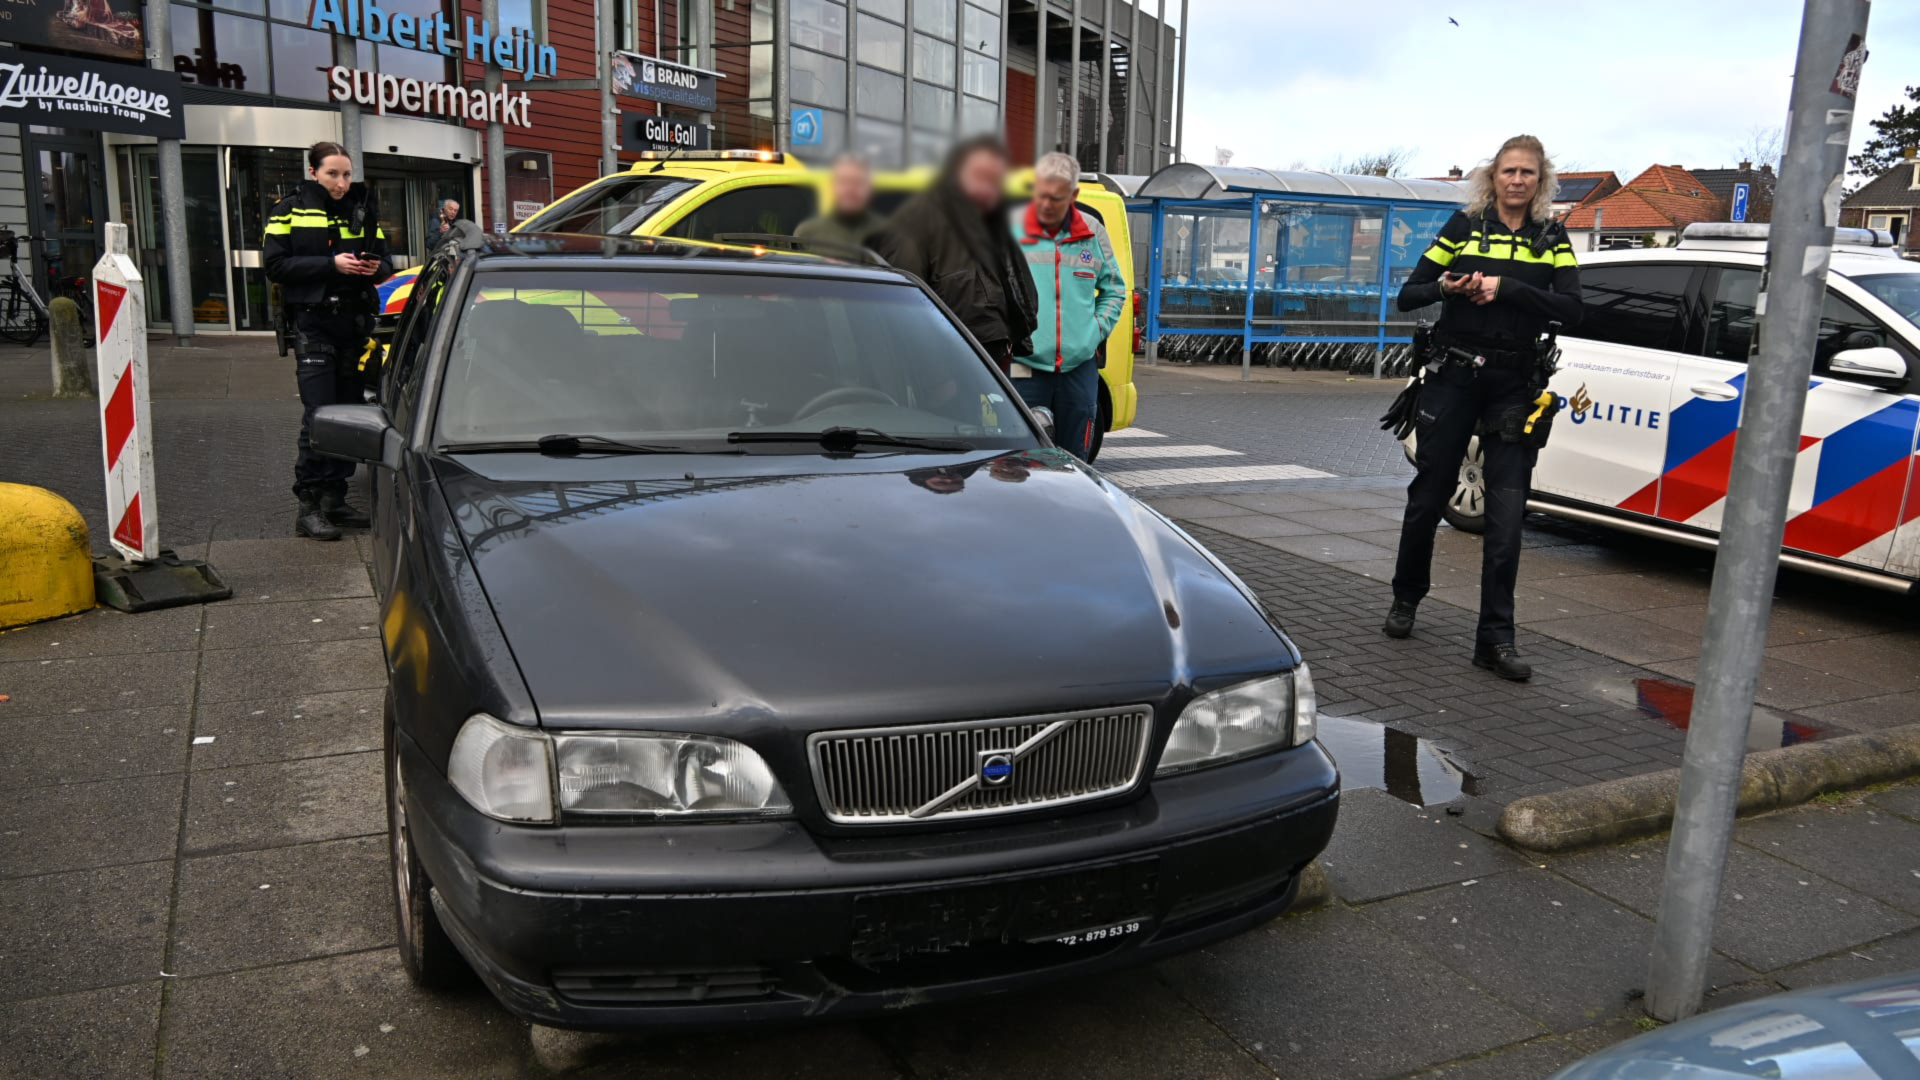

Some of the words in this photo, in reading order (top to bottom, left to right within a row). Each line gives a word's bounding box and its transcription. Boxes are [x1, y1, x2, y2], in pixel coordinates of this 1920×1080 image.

[309, 0, 452, 56] Albert
[465, 16, 557, 81] Heijn
[657, 67, 698, 89] BRAND
[0, 63, 171, 118] Zuivelhoeve
[330, 65, 532, 128] supermarkt
[633, 81, 712, 106] visspecialiteiten
[38, 98, 52, 112] by
[57, 100, 109, 114] Kaashuis
[112, 105, 146, 122] Tromp
[1736, 187, 1745, 206] P
[1573, 362, 1612, 373] waakzaam
[1622, 367, 1665, 381] dienstbaar
[1558, 396, 1661, 429] POLITIE
[1085, 929, 1107, 942] 879
[1109, 926, 1123, 937] 53
[1125, 922, 1139, 933] 39
